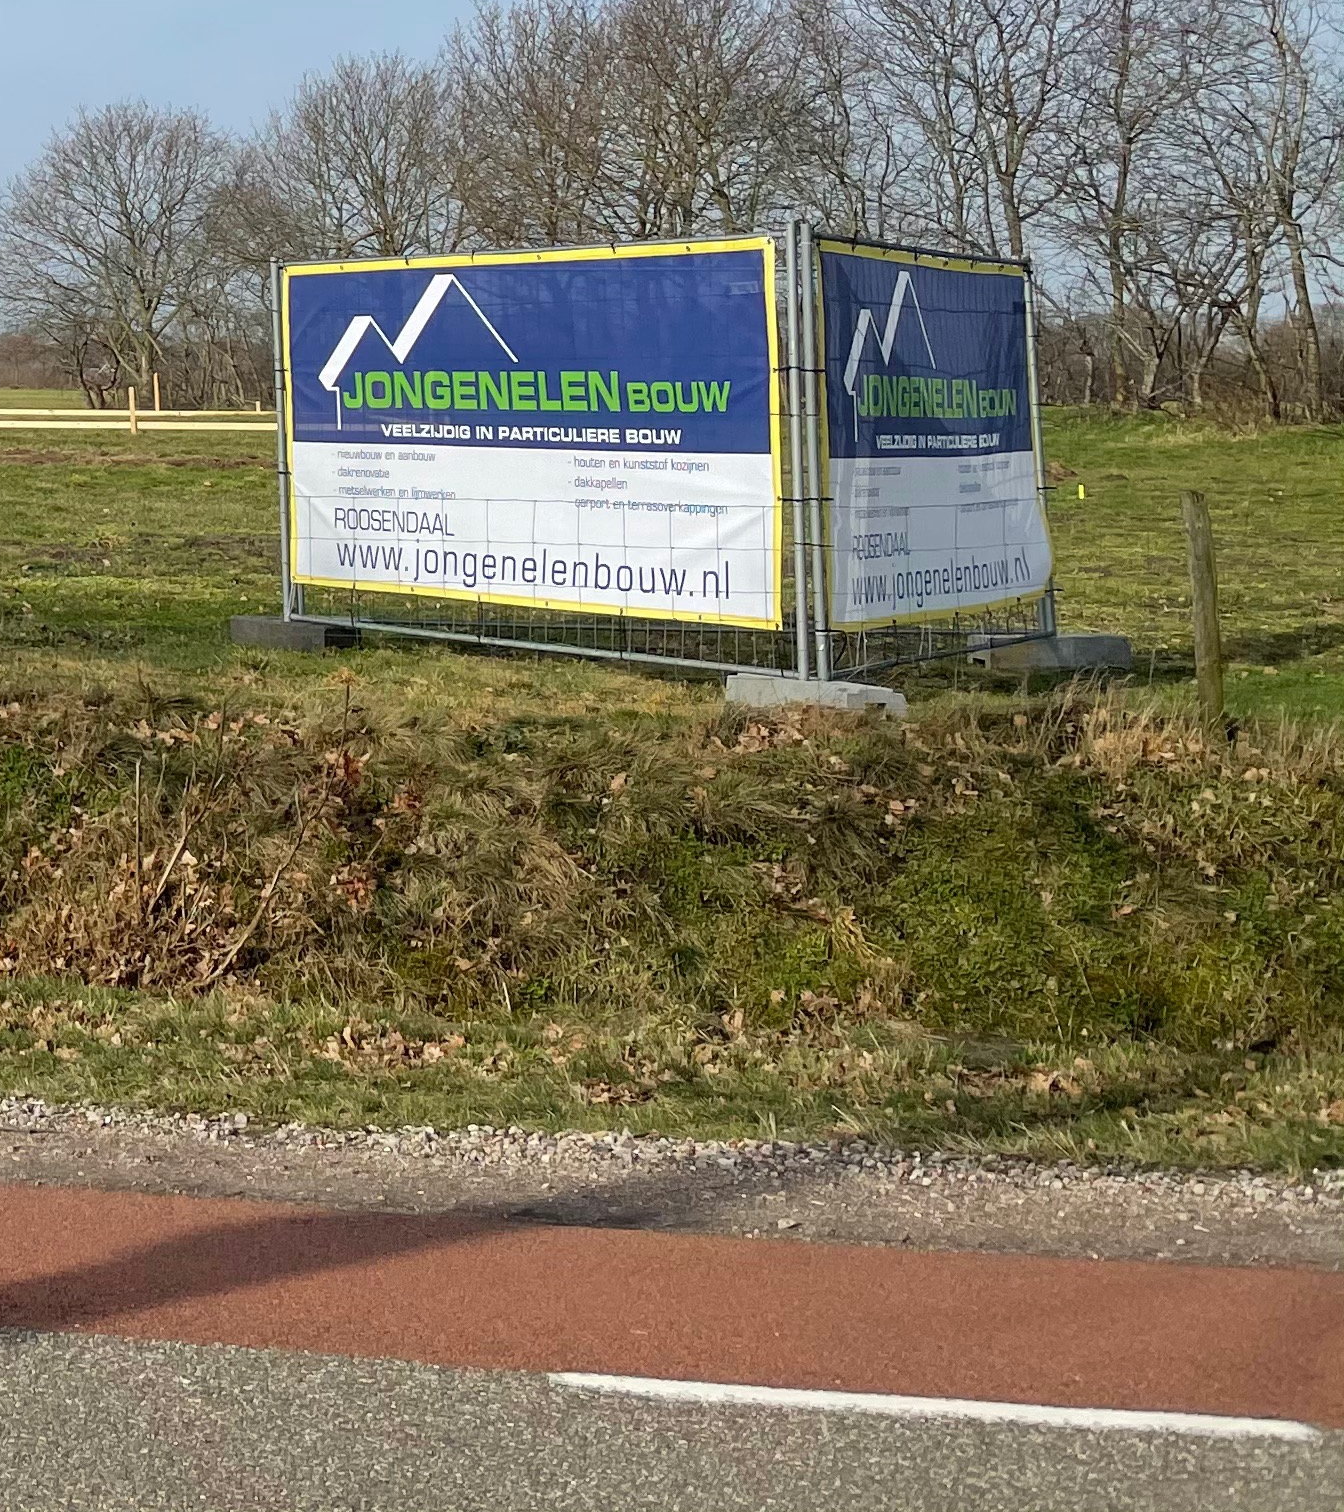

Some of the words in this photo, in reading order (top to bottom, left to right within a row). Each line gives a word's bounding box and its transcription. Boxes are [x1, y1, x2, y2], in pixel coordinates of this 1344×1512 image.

[343, 370, 621, 412] JONGENELEN
[626, 380, 731, 413] BOUW
[858, 374, 977, 419] JONGENELEN
[381, 423, 471, 440] VEELZIJDIG
[476, 425, 494, 440] IN
[499, 426, 620, 444] PARTICULIERE
[625, 428, 682, 445] BOUW
[337, 449, 383, 460] nieuwbouw
[385, 451, 395, 460] en
[398, 450, 436, 462] aanbouw
[573, 456, 605, 469] houten
[609, 459, 620, 469] en
[623, 458, 668, 471] kunststof
[670, 459, 710, 474] kozijnen
[337, 467, 390, 479] dakrenovatie
[574, 476, 628, 491] dakkapellen
[338, 485, 395, 497] metselwerken
[399, 488, 409, 498] en
[334, 507, 455, 537] ROOSENDAAL
[852, 532, 911, 560] ROOSENDAAL
[336, 538, 730, 599] www.jongenelenbouw.nl
[852, 545, 1031, 611] www.jongenelenbouw.nl
